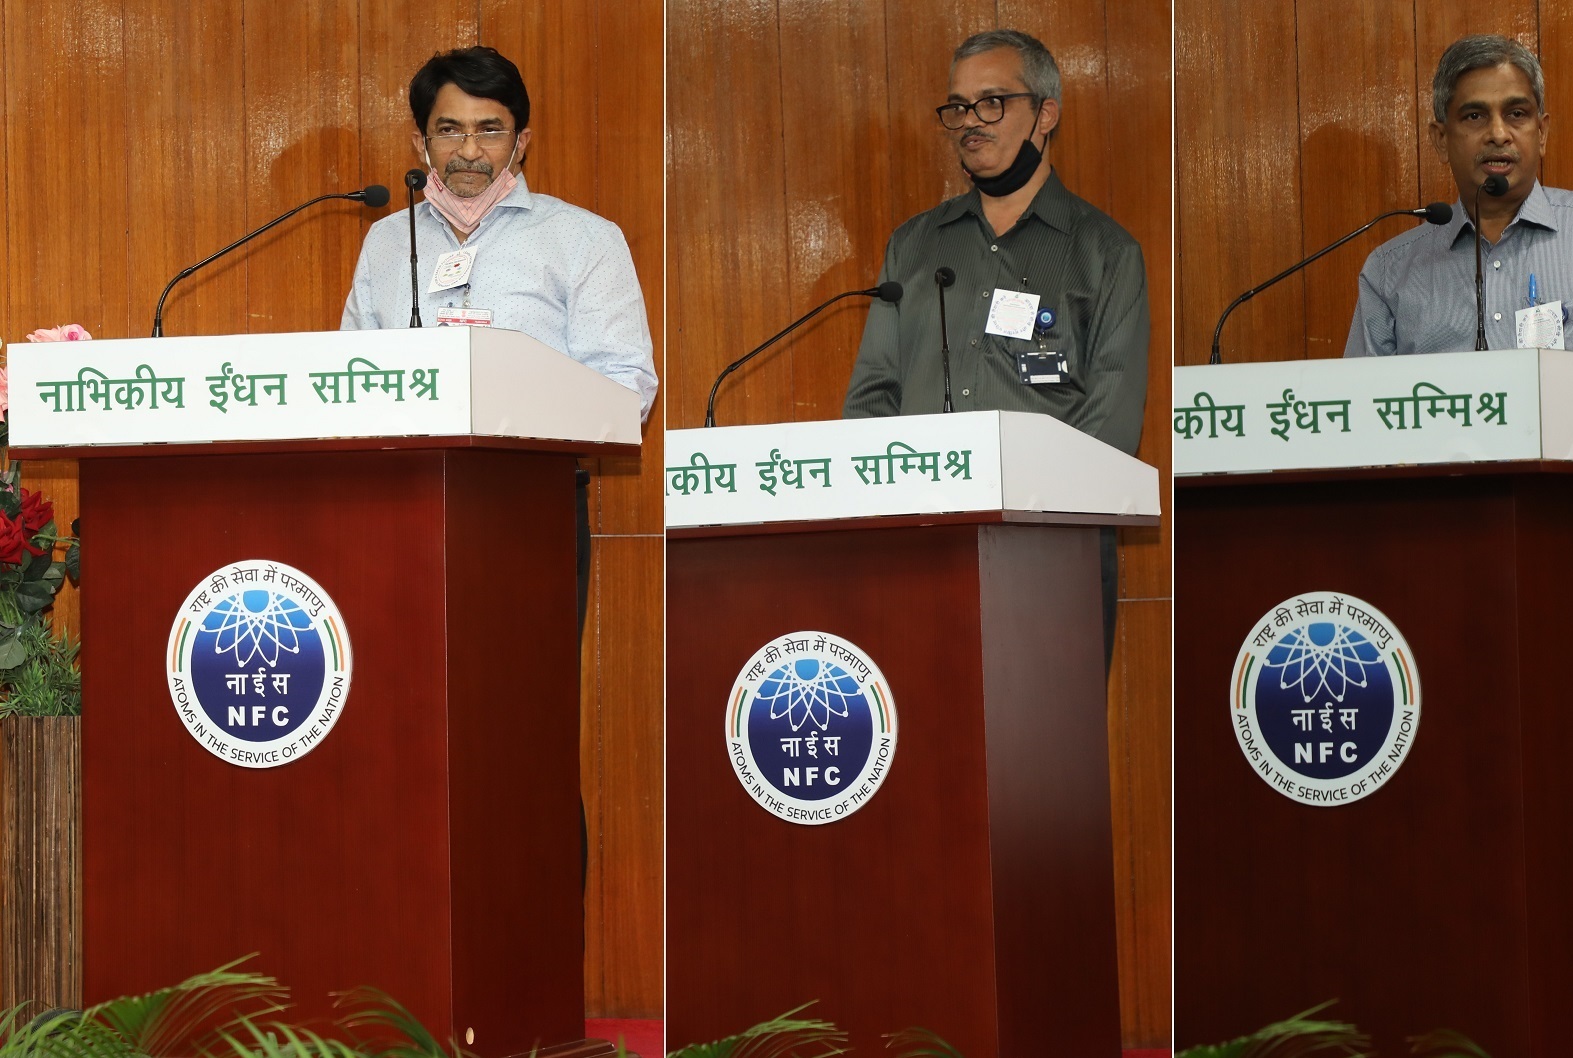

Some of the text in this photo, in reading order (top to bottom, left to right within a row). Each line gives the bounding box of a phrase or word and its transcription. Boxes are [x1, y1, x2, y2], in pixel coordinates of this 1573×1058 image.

[38, 358, 438, 412] नाभिकीय ईंधन सम्मिश्र
[1267, 388, 1350, 440] ईंधन
[1374, 382, 1506, 429] सम्मिश्र
[756, 449, 830, 495] ईंधन
[853, 442, 971, 484] सम्मिश्र
[189, 564, 326, 618] राष्ट्र की सेवा में परमाणु
[1252, 595, 1394, 650] राष्ट्र की सेवा में परमाणु
[745, 634, 873, 684] राष्ट्र की सेवा में परमाणु
[172, 676, 344, 764] ATOMS IN THE SERVICE OF THE NATION
[227, 705, 290, 727] NFC
[731, 737, 891, 821] ATOMS IN THE SERVICE OF THE NATION
[783, 766, 841, 787] NFC
[1236, 710, 1414, 802] ATOMS IN THE SERVICE OF THE NATION
[1294, 741, 1358, 764] NFC
